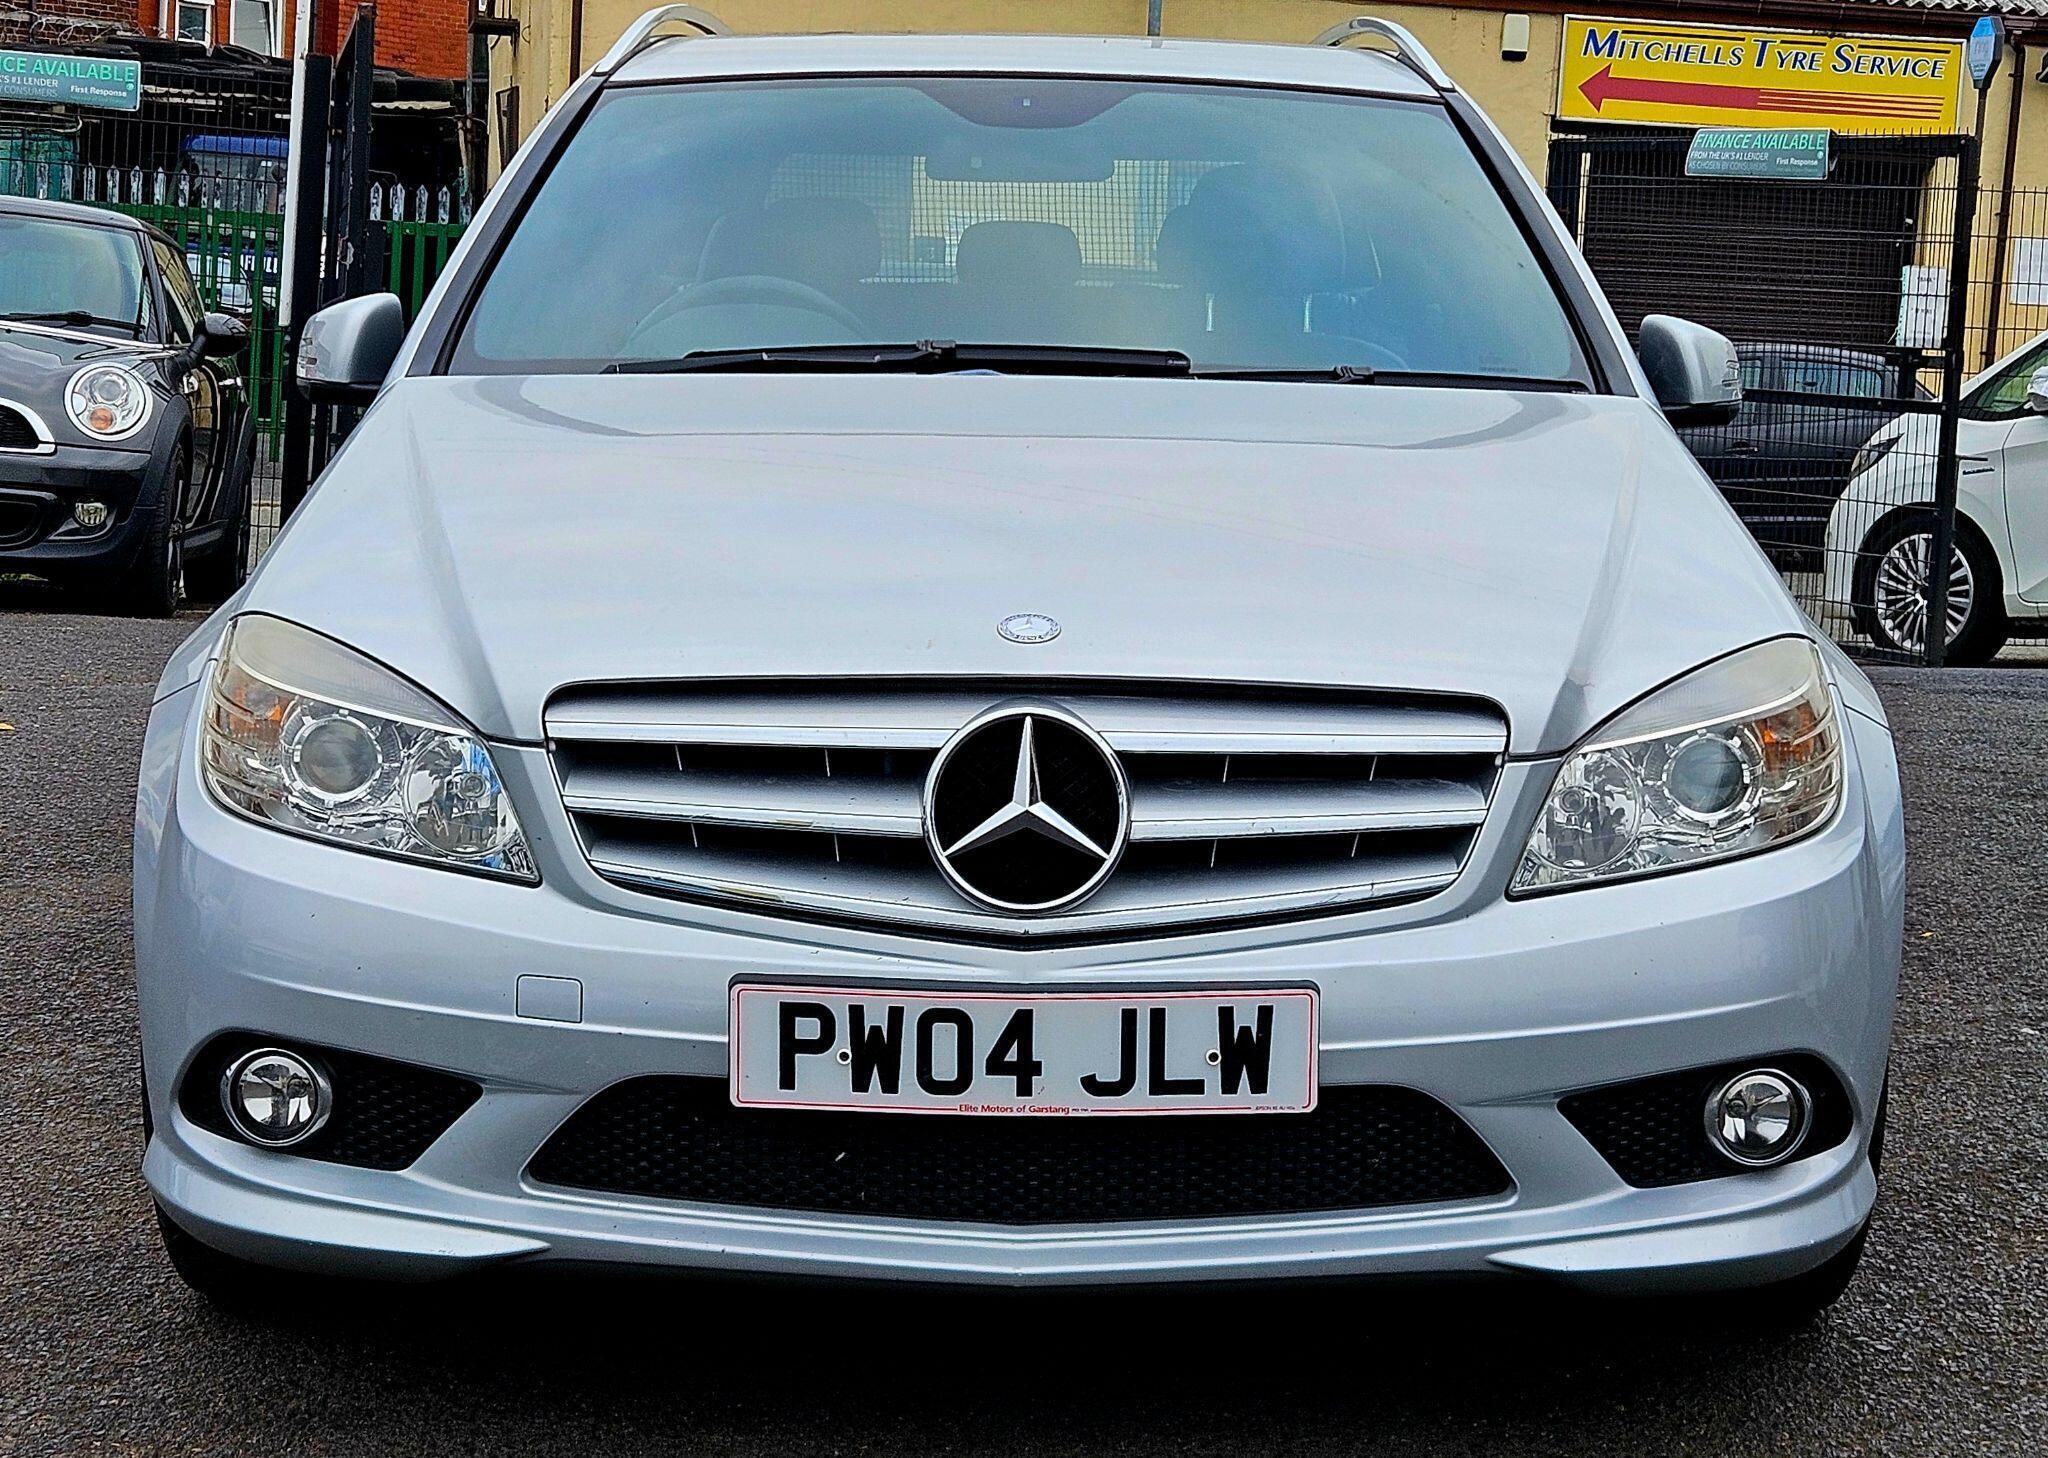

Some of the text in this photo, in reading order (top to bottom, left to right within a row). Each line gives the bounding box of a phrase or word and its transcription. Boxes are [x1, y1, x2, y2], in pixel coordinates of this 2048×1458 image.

[1582, 27, 1947, 79] MITCHELLS TYRE SERVICE
[0, 55, 135, 81] CE AVAILABLE
[23, 77, 59, 88] LENDER
[4, 85, 58, 98] CONSUMERS
[70, 85, 127, 97] First Response
[1694, 134, 1825, 150] FINANCE AVAILABLE
[1690, 150, 1708, 160] FROM
[1708, 151, 1720, 160] THE
[1744, 151, 1769, 161] LENDER
[1776, 157, 1818, 167] First Response
[778, 1000, 1274, 1098] PW04 JLW
[959, 1104, 978, 1113] Elite
[980, 1105, 1013, 1113] Motors
[1016, 1105, 1026, 1113] of
[1028, 1105, 1070, 1115] Garstang
